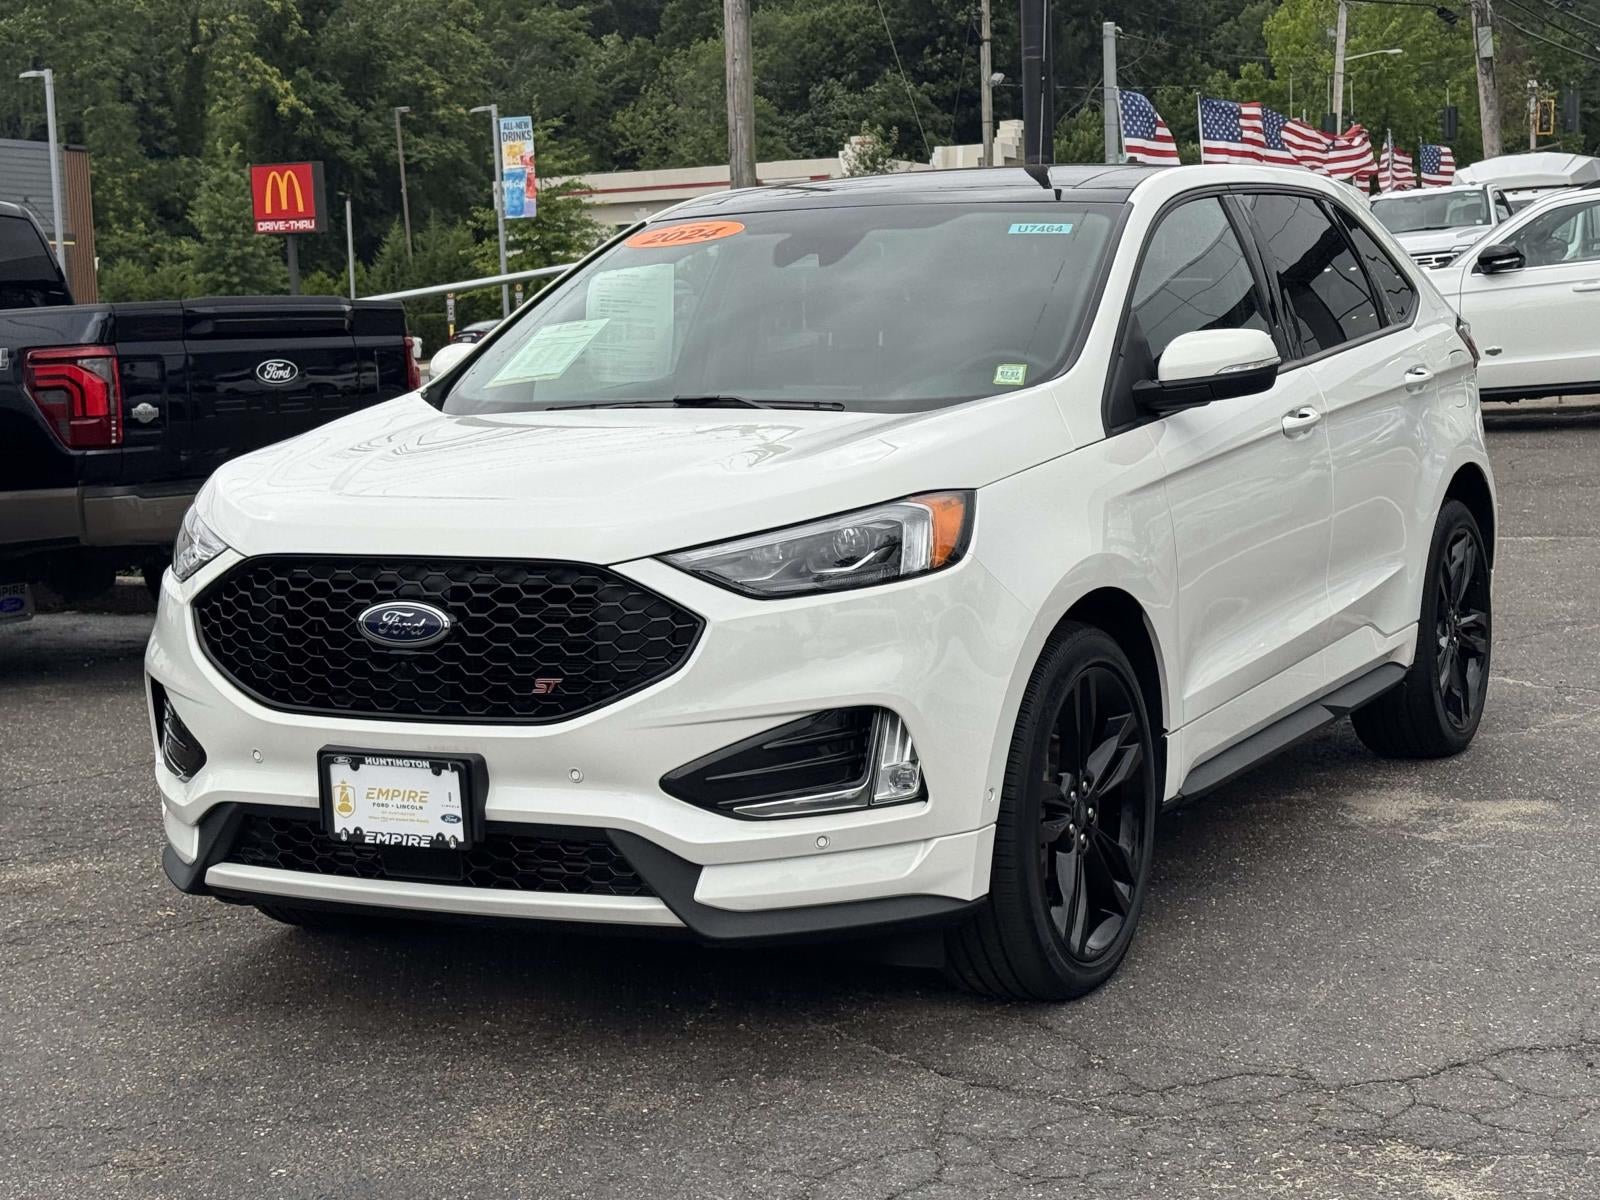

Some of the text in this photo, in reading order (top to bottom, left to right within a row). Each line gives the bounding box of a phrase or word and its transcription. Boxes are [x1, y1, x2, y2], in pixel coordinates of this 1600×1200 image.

[503, 121, 529, 130] ALL-NEW
[502, 130, 532, 142] DRINKS
[257, 219, 315, 231] DRIVE-THRU
[1017, 224, 1064, 233] U7464
[641, 226, 728, 245] 2024
[264, 362, 291, 379] Ford
[378, 610, 426, 635] Ford
[532, 678, 563, 693] ST
[364, 756, 430, 769] HUNTINGTON
[365, 787, 430, 803] EMPIRE
[364, 831, 431, 848] EMPIRE
